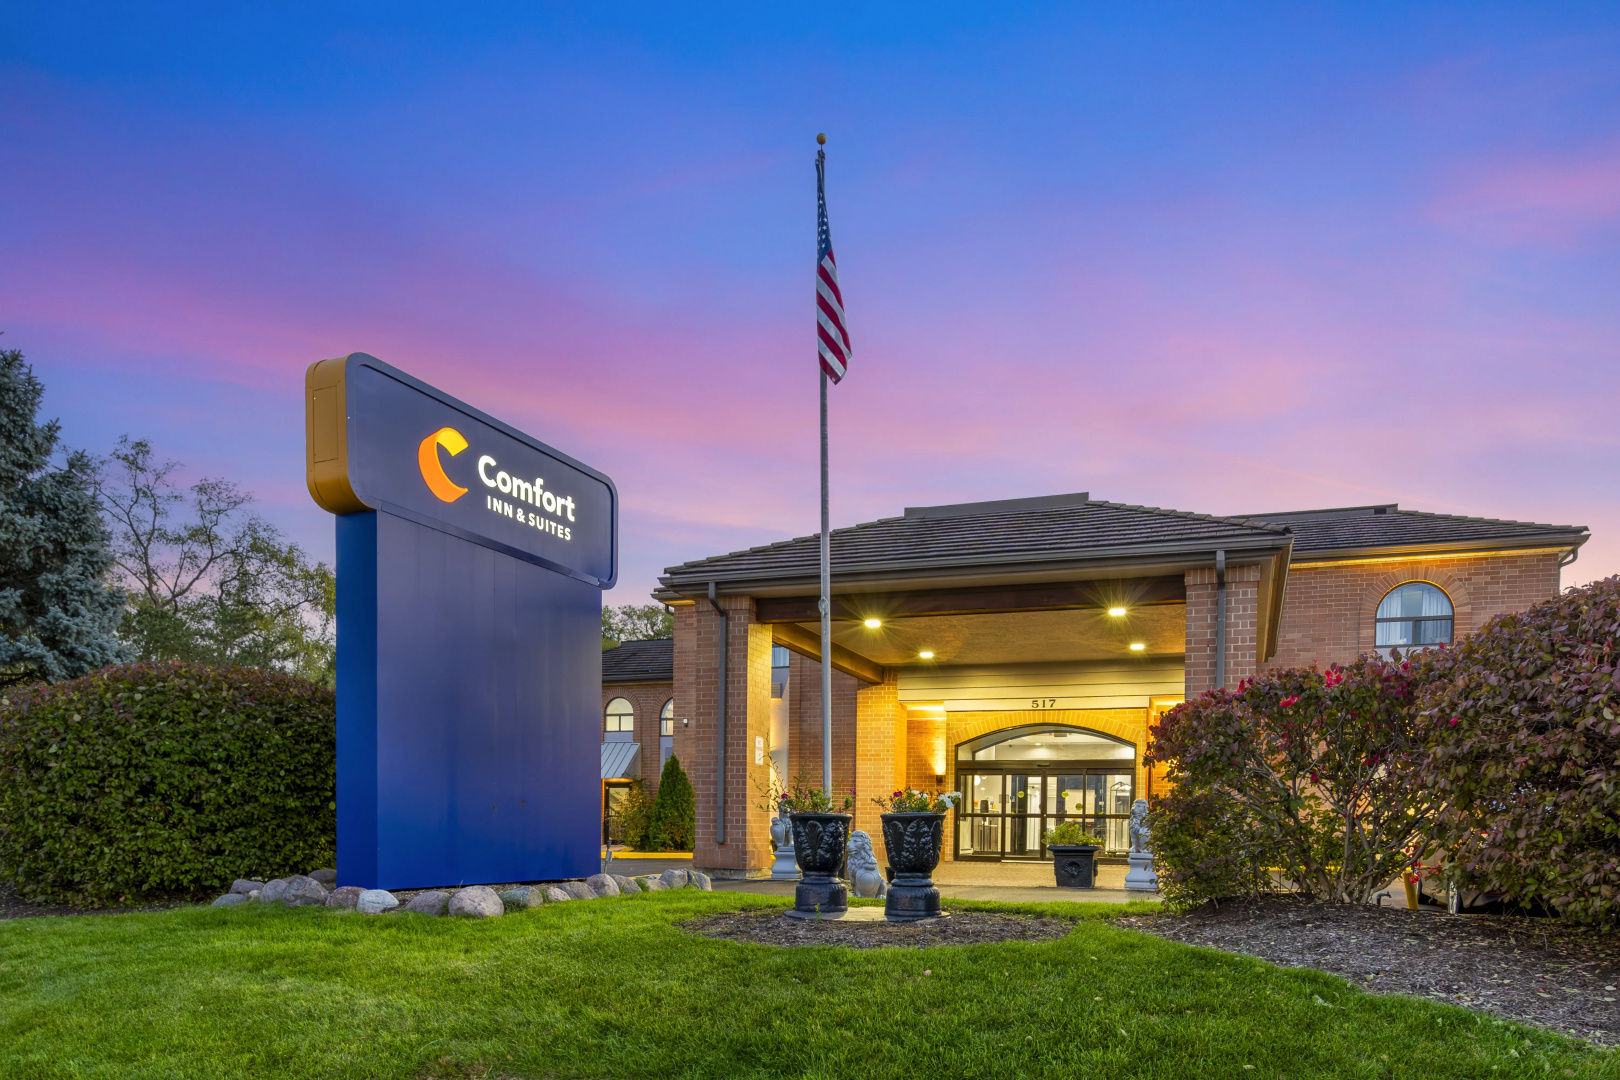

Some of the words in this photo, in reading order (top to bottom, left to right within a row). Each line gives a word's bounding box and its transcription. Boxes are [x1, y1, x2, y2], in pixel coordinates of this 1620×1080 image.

[478, 455, 575, 522] Comfort
[487, 495, 513, 518] INN
[516, 508, 525, 523] &
[528, 513, 571, 541] SUITES
[1031, 699, 1056, 708] 517
